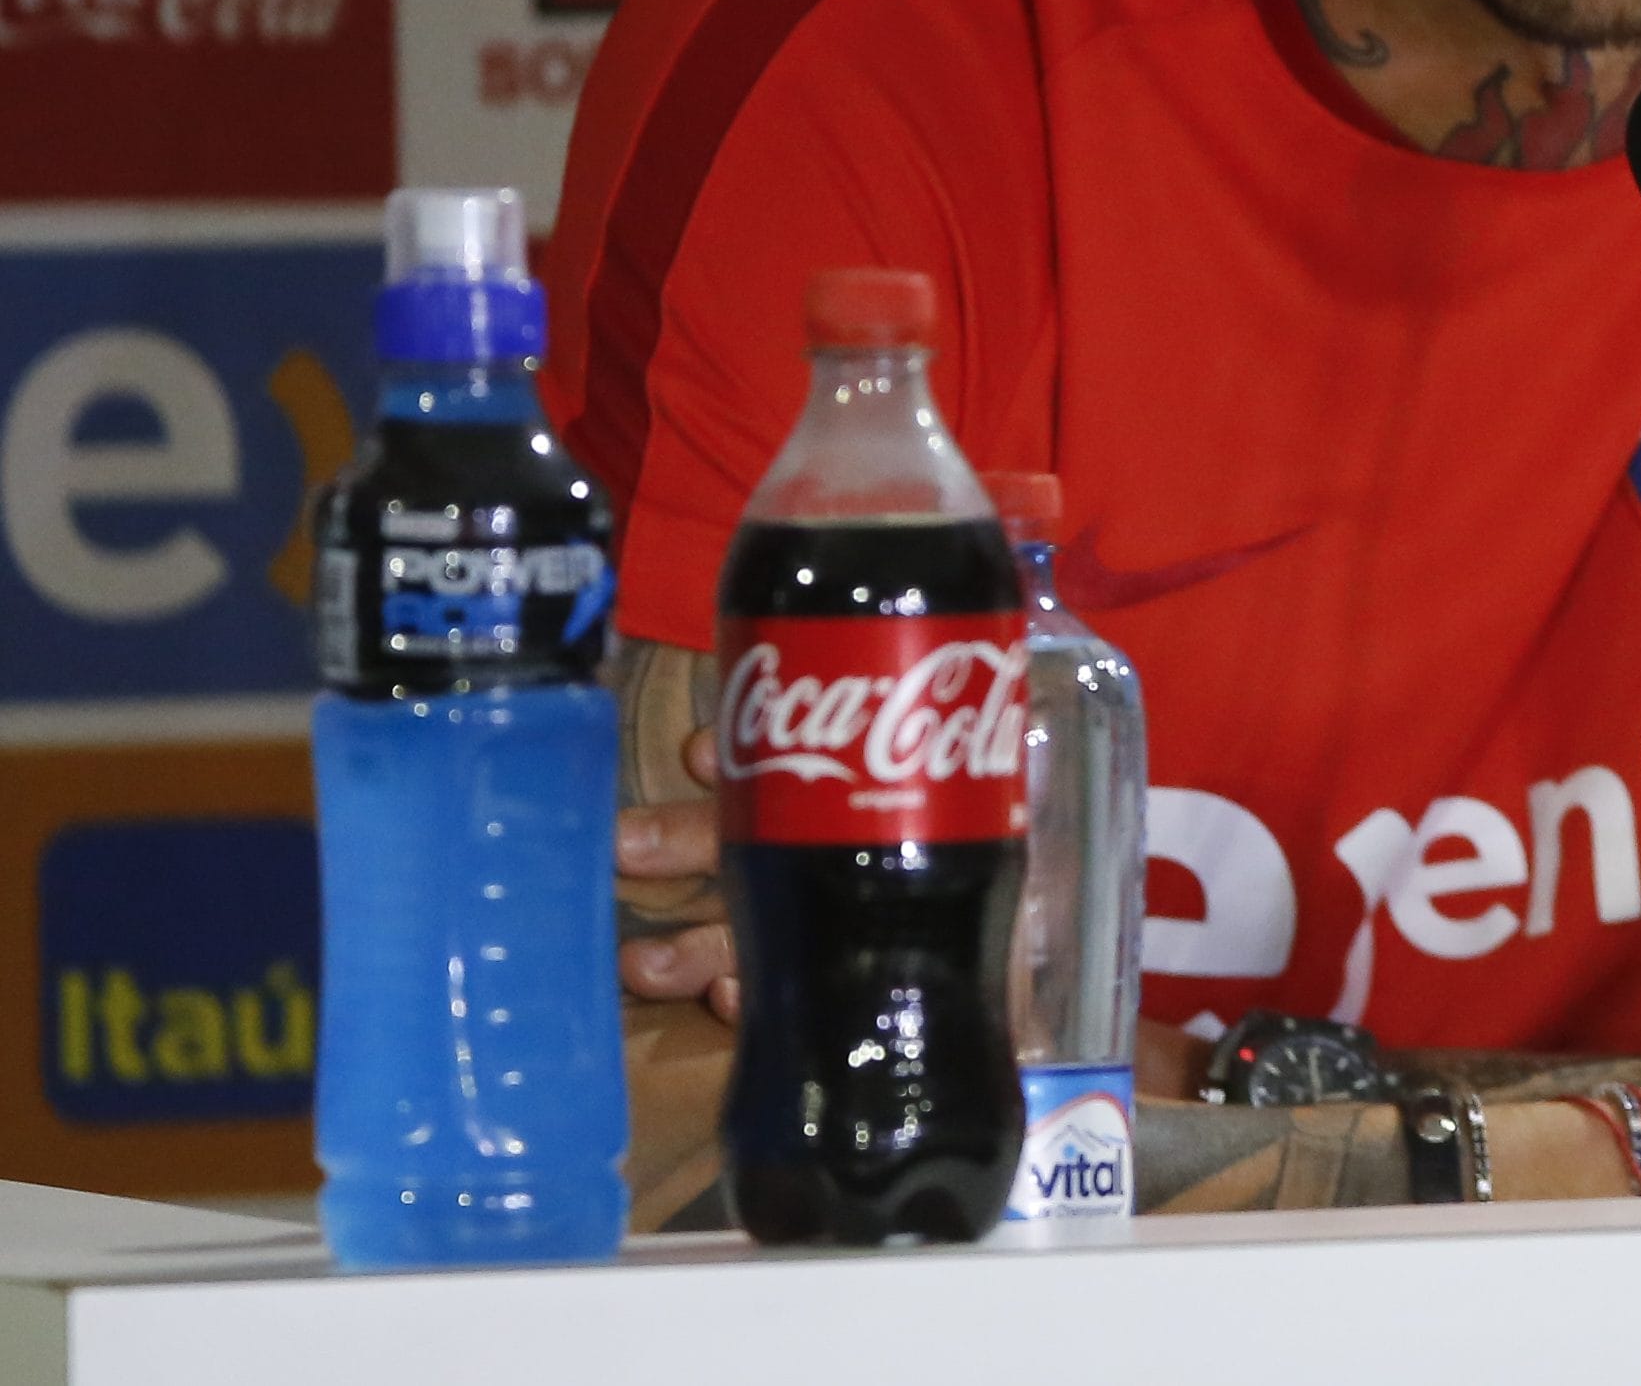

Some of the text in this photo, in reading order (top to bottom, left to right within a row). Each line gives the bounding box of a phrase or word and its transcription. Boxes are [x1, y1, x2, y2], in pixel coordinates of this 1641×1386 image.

[718, 640, 1032, 784] Coca-Cola
[58, 959, 312, 1086] Itaú
[1031, 1153, 1125, 1200] vital
